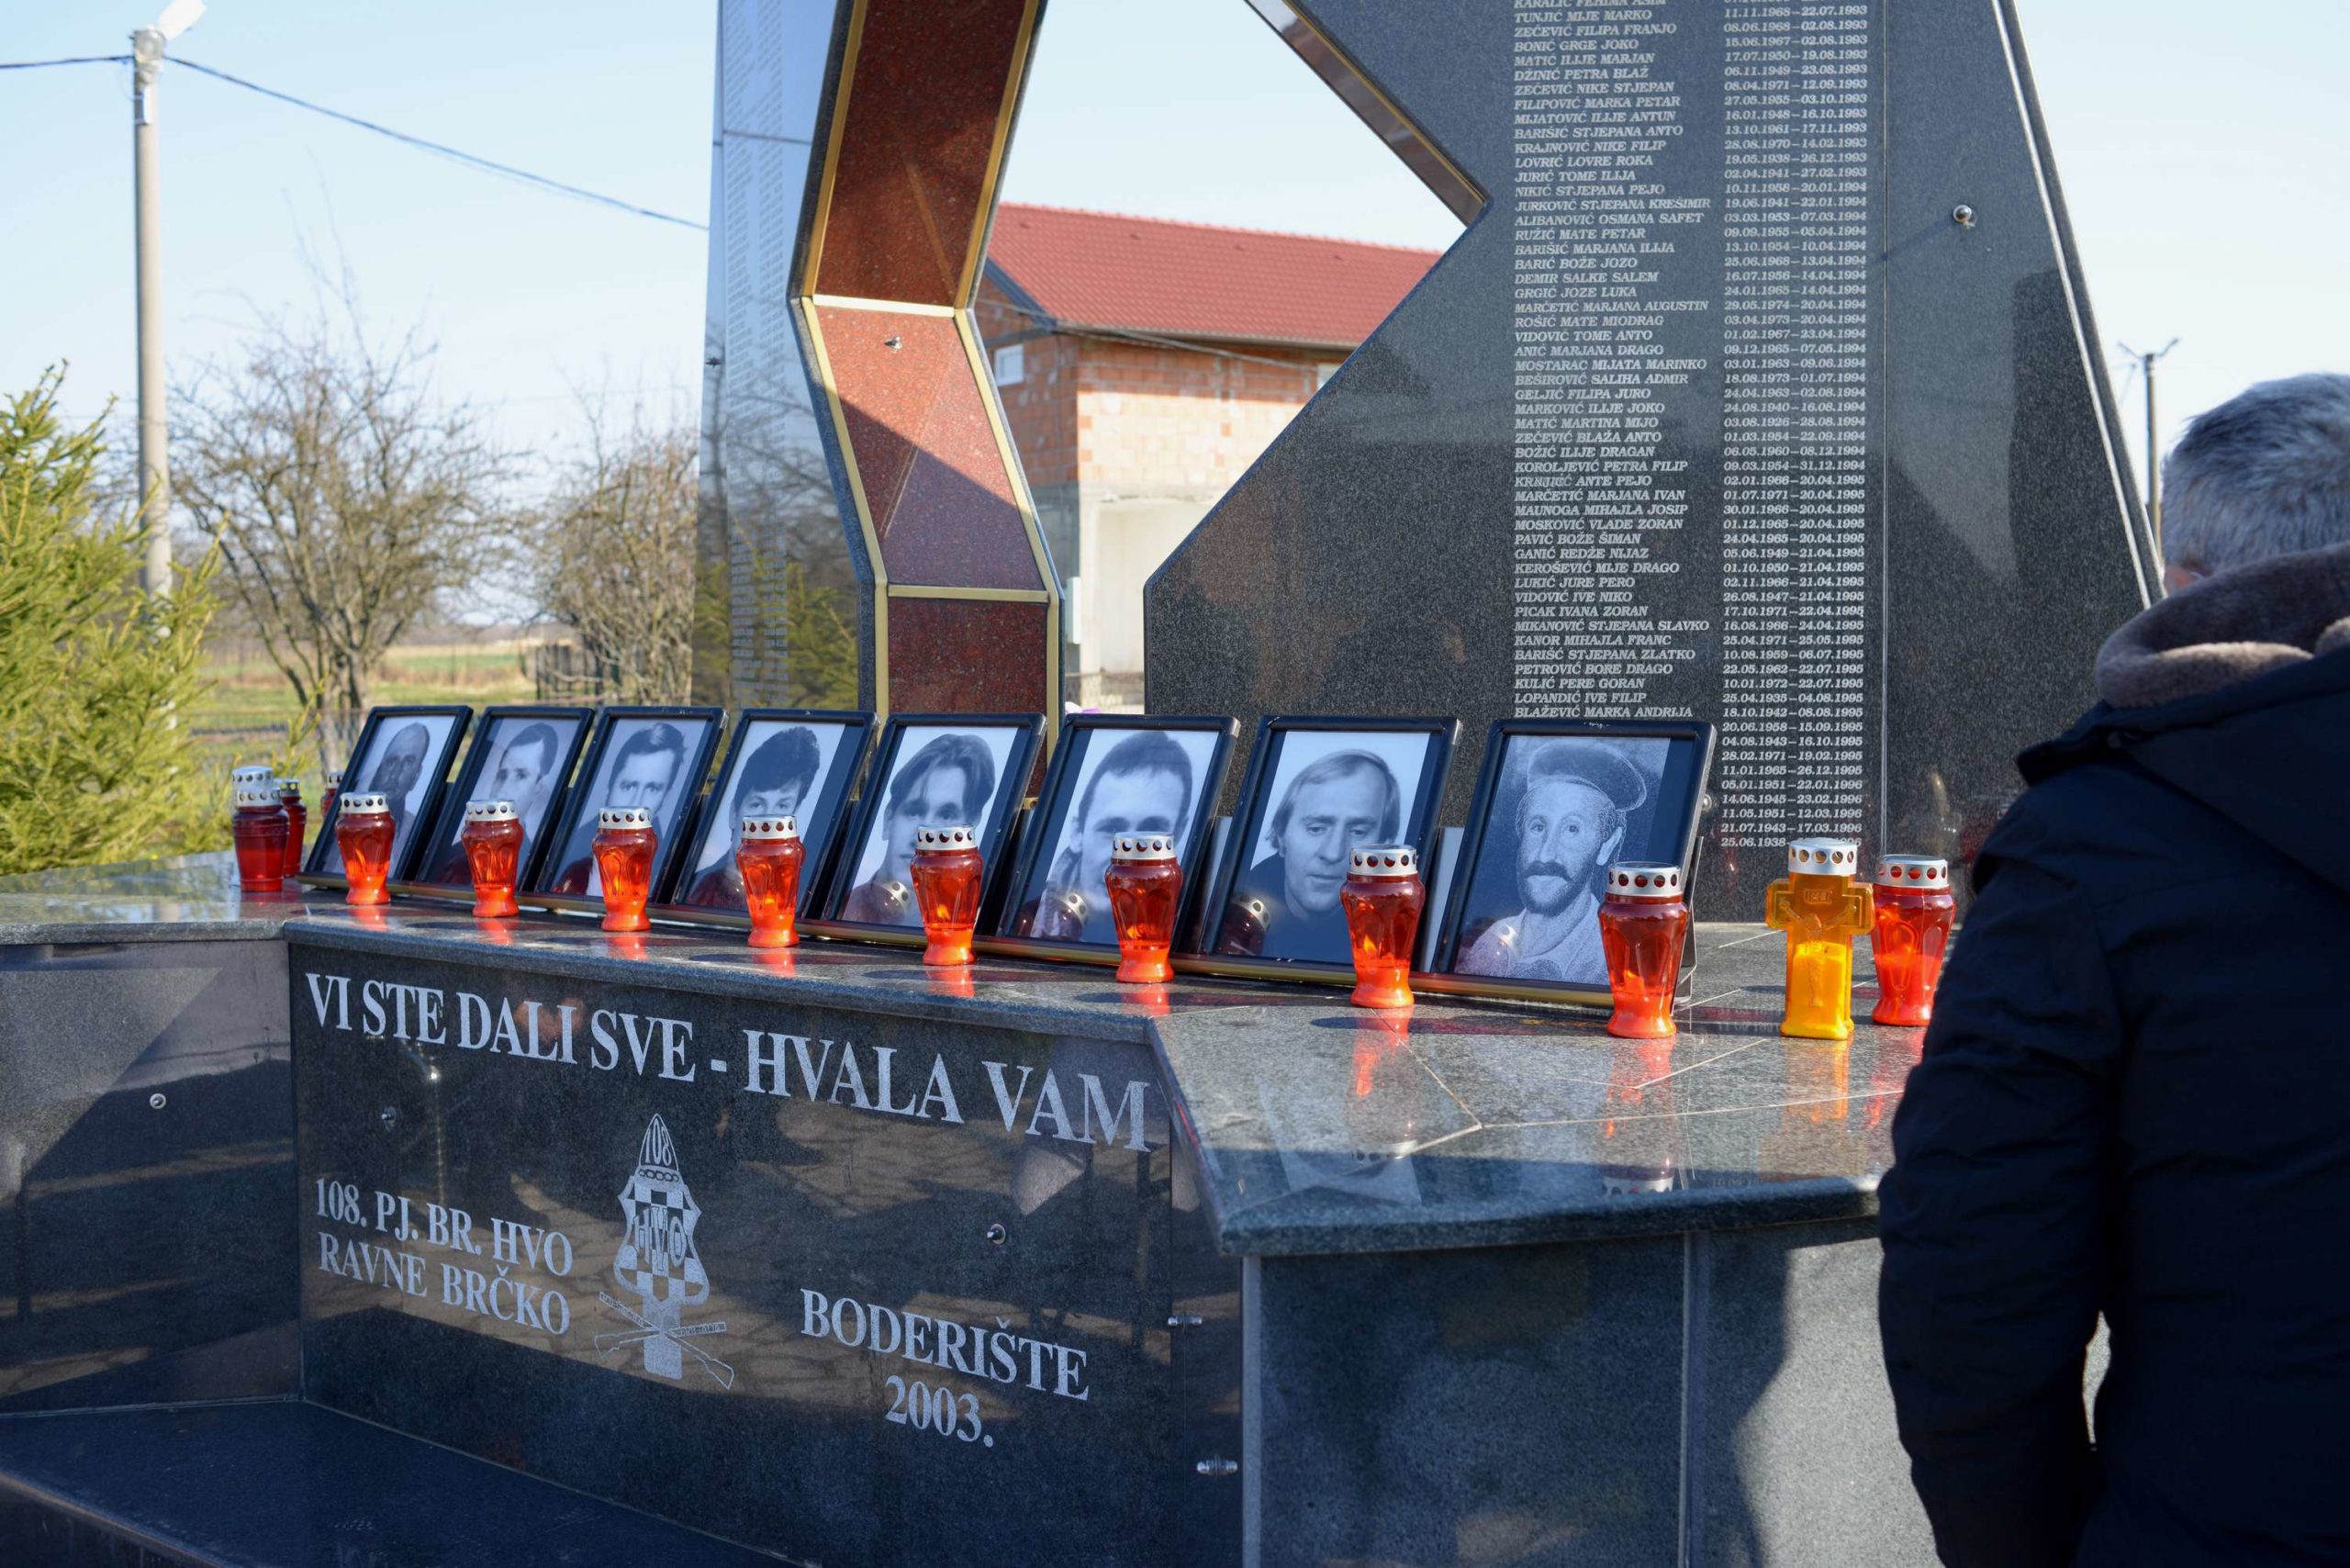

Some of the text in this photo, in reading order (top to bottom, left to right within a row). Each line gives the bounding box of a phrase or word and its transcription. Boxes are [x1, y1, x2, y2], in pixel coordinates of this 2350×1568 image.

[1514, 8, 1653, 23] TUNJIĆ MIJE MARKO
[1514, 52, 1656, 67] MATIĆ ILIJE MARJAN
[1514, 95, 1682, 110] FILIPOVIĆ MARKA PETAR
[1515, 139, 1668, 154] KRAJNOVIĆ NIKE FILIP
[1514, 196, 1712, 212] JURKOVIĆ STJEPANA KREŠIMIR
[1514, 211, 1706, 226] ALIBANOVIĆ OSMANA SAFET
[1514, 227, 1647, 241] RUŽIĆ MATE PETAR
[1514, 241, 1676, 255] BARIŠIĆ MARJANA ILIJA
[1514, 255, 1639, 270] BARIĆ BOŽE JOZO
[1514, 271, 1661, 285] DEMIR SALKE SALEM
[1600, 286, 1638, 297] LUKA
[1514, 299, 1710, 314] MARČETIĆ MARJANA AUGUSTIN
[1514, 314, 1665, 328] ROŠIĆ MATE MIODRAG
[1514, 328, 1654, 342] VIDOVIĆ TOME ANTO
[1514, 343, 1665, 357] ANIĆ MARJANA DRAGO
[1514, 358, 1708, 372] MOSTARAC MIJATA MARINKO
[1514, 372, 1689, 386] BEŠIROVIĆ SALIHA ADMIR
[1514, 386, 1652, 400] GELJIĆ FILIPA JURO
[1514, 400, 1666, 415] MARKOVIĆ ILIJE JOKO
[1514, 415, 1660, 430] MATIĆ MARTINA MIJO
[1514, 430, 1663, 443] ZEČEVIĆ BLAŽA ANTO
[1514, 444, 1656, 458] BOŽIĆ ILIJE DRAGAN
[1514, 459, 1689, 473] KOROLJEVIĆ PETRA FILIP
[1574, 476, 1653, 487] ANTE PEJO
[1514, 487, 1686, 502] MARČETIĆ MARJANA IVAN
[1582, 504, 1645, 516] MIHAJLA
[1646, 504, 1689, 516] JOSIP
[1514, 517, 1684, 531] MOSKOVIĆ VLADE ZORAN
[1514, 531, 1554, 545] PAVIĆ
[1556, 531, 1595, 544] BOŽE
[1514, 545, 1556, 560] GANIĆ
[1608, 547, 1651, 559] NIJAZ
[1514, 560, 1681, 574] KEROŠEVIĆ MIJE DRAGO
[1514, 575, 1637, 588] LUKIĆ JURE PERO
[1514, 589, 1634, 603] VIDOVIĆ IVE NIKO
[1514, 606, 1650, 617] PICAK IVANA ZORAN
[1514, 618, 1710, 632] MIKANOVIĆ STJEPANA SLAVKO
[1514, 635, 1673, 646] KANOR MIHAJLA FRANC
[1567, 649, 1639, 660] STJEPANA
[1639, 649, 1696, 660] ZLATKO
[1514, 661, 1583, 675] PETROVIĆ
[1625, 664, 1674, 675] DRAGO
[1514, 676, 1647, 689] KULIĆ PERE GORAN
[1514, 689, 1648, 703] LOPANDIĆ IVE FILIP
[1514, 705, 1694, 718] BLAŽEVIĆ MARKA ANDRIJA
[306, 972, 352, 1031] VI
[363, 980, 447, 1046] STE
[456, 991, 577, 1065] DALI
[590, 1008, 697, 1082] SVE
[742, 1028, 965, 1125] HVALA
[981, 1060, 1152, 1153] VAM
[644, 1119, 673, 1167] 108
[316, 1177, 574, 1277] 108. PJ. BR. HVO
[632, 1204, 688, 1272] HVO
[318, 1231, 428, 1297] RAVNE
[441, 1262, 571, 1336] BRČKO
[800, 1287, 1090, 1402] BODERIŠTE
[885, 1374, 994, 1448] 2003.
